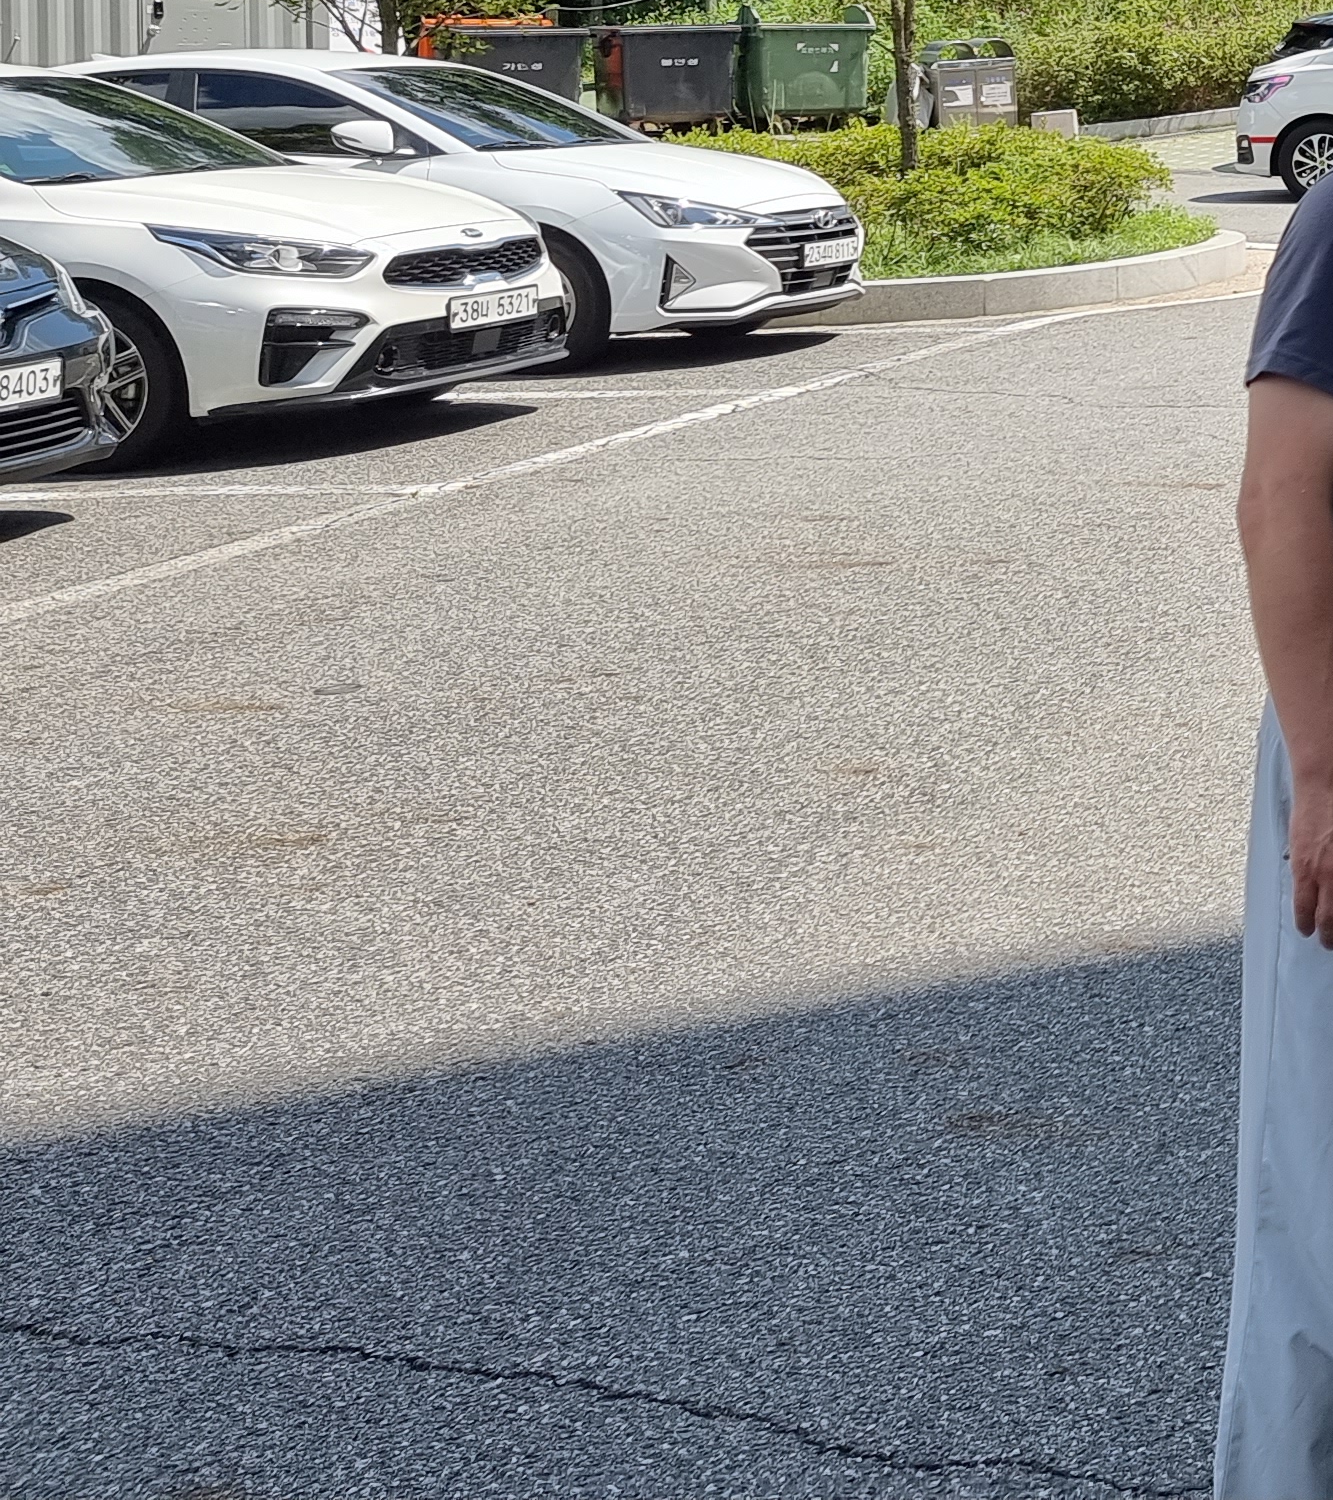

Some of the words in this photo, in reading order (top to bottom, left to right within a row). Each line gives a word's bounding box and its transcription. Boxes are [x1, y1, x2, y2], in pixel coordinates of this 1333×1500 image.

[460, 299, 490, 323] 38나
[497, 292, 530, 317] 5321
[0, 367, 50, 401] 8403
